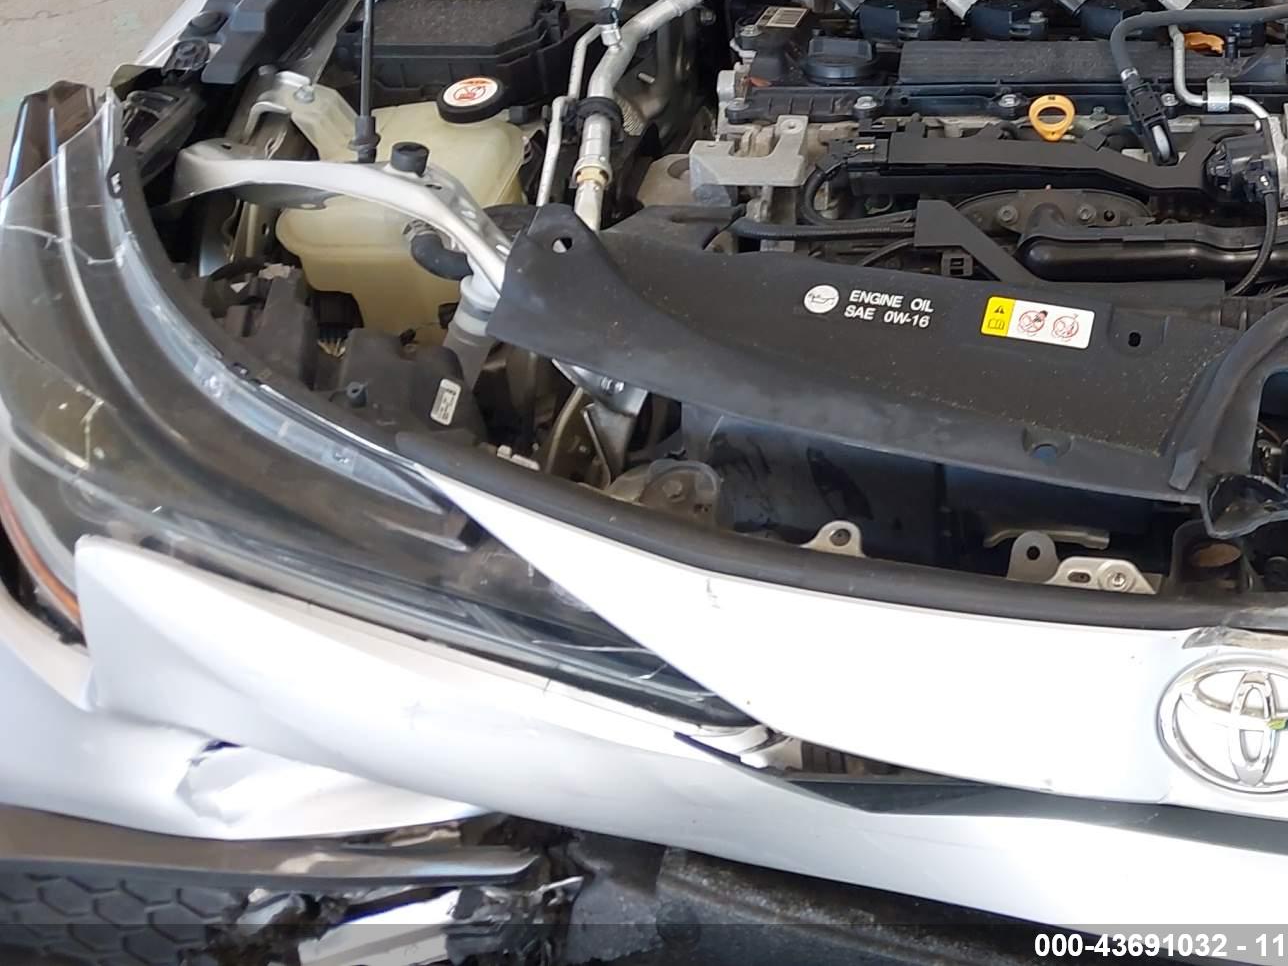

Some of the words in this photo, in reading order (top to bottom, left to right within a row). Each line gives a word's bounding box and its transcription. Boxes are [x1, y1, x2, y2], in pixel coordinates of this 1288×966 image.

[849, 289, 904, 308] ENGINE
[910, 297, 935, 313] OIL
[843, 304, 877, 321] SAE
[883, 310, 931, 328] 0W-16
